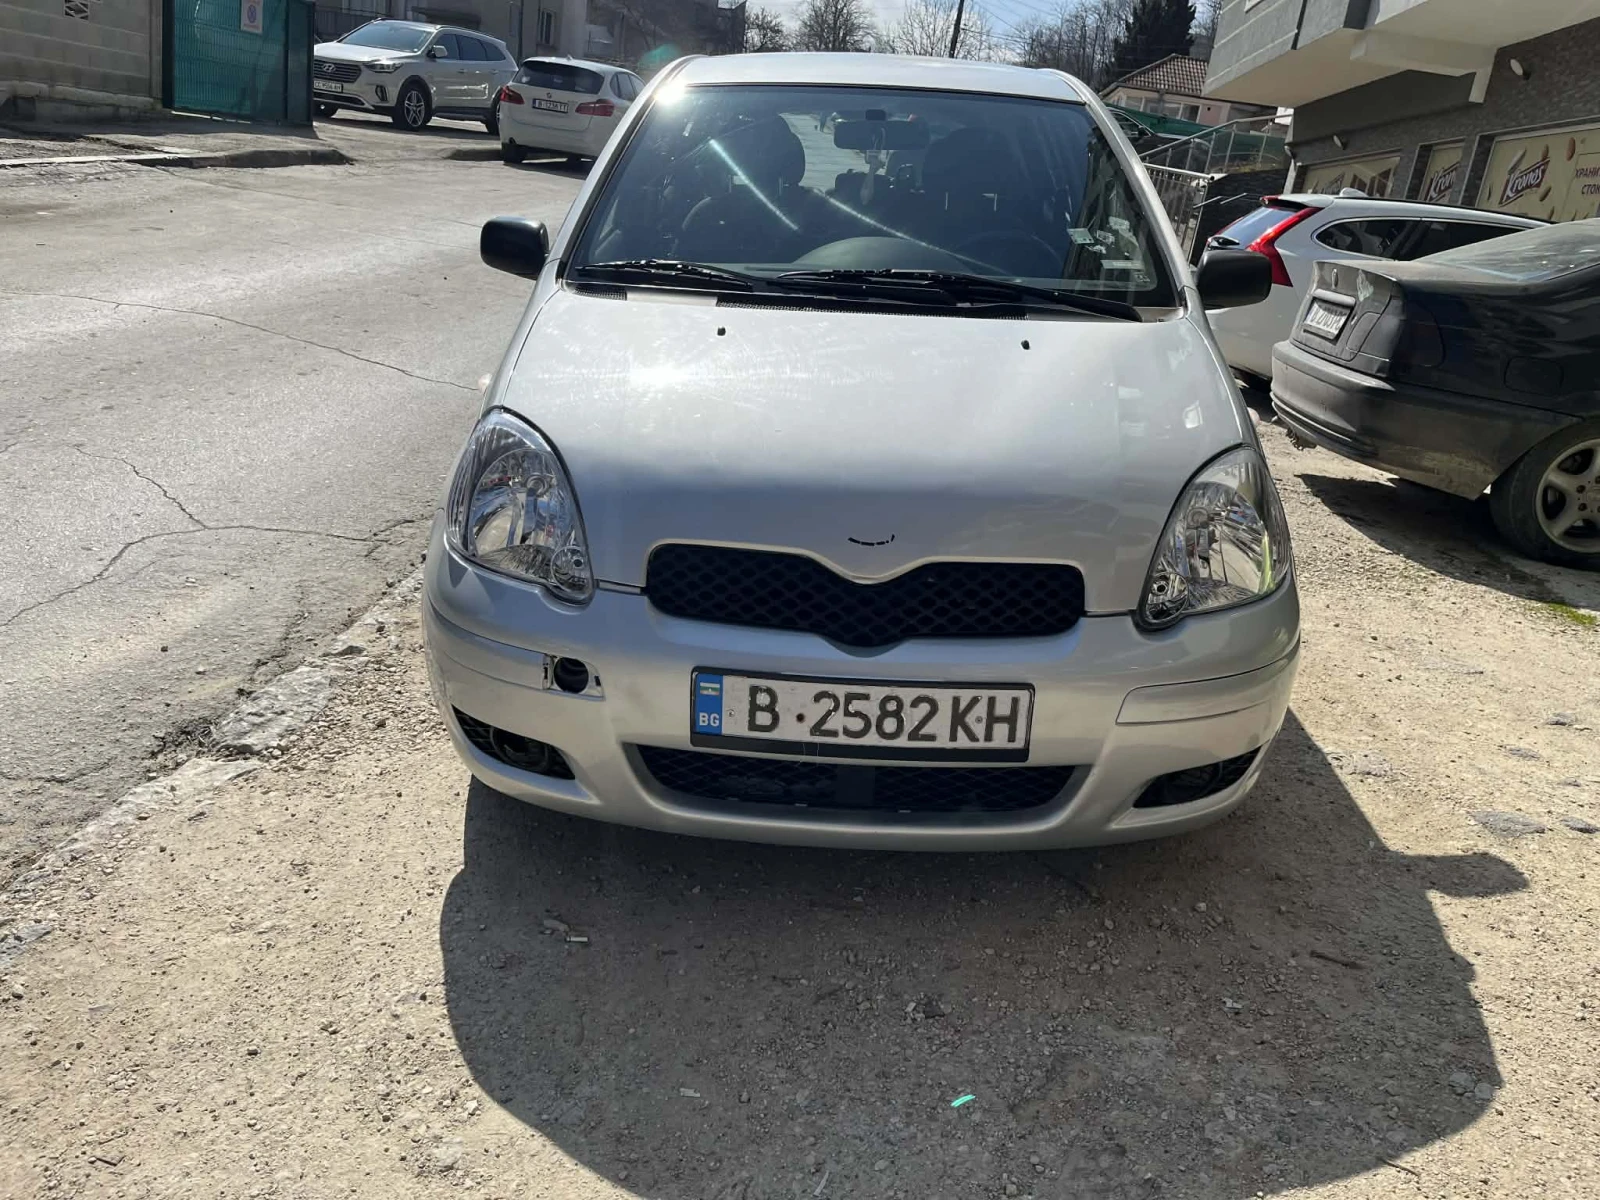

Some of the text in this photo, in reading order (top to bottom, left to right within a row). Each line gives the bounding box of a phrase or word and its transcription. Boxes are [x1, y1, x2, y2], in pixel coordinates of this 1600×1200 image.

[1575, 167, 1600, 179] ХРАНИ
[699, 712, 720, 727] BG
[748, 685, 1020, 743] B 2582 KH
